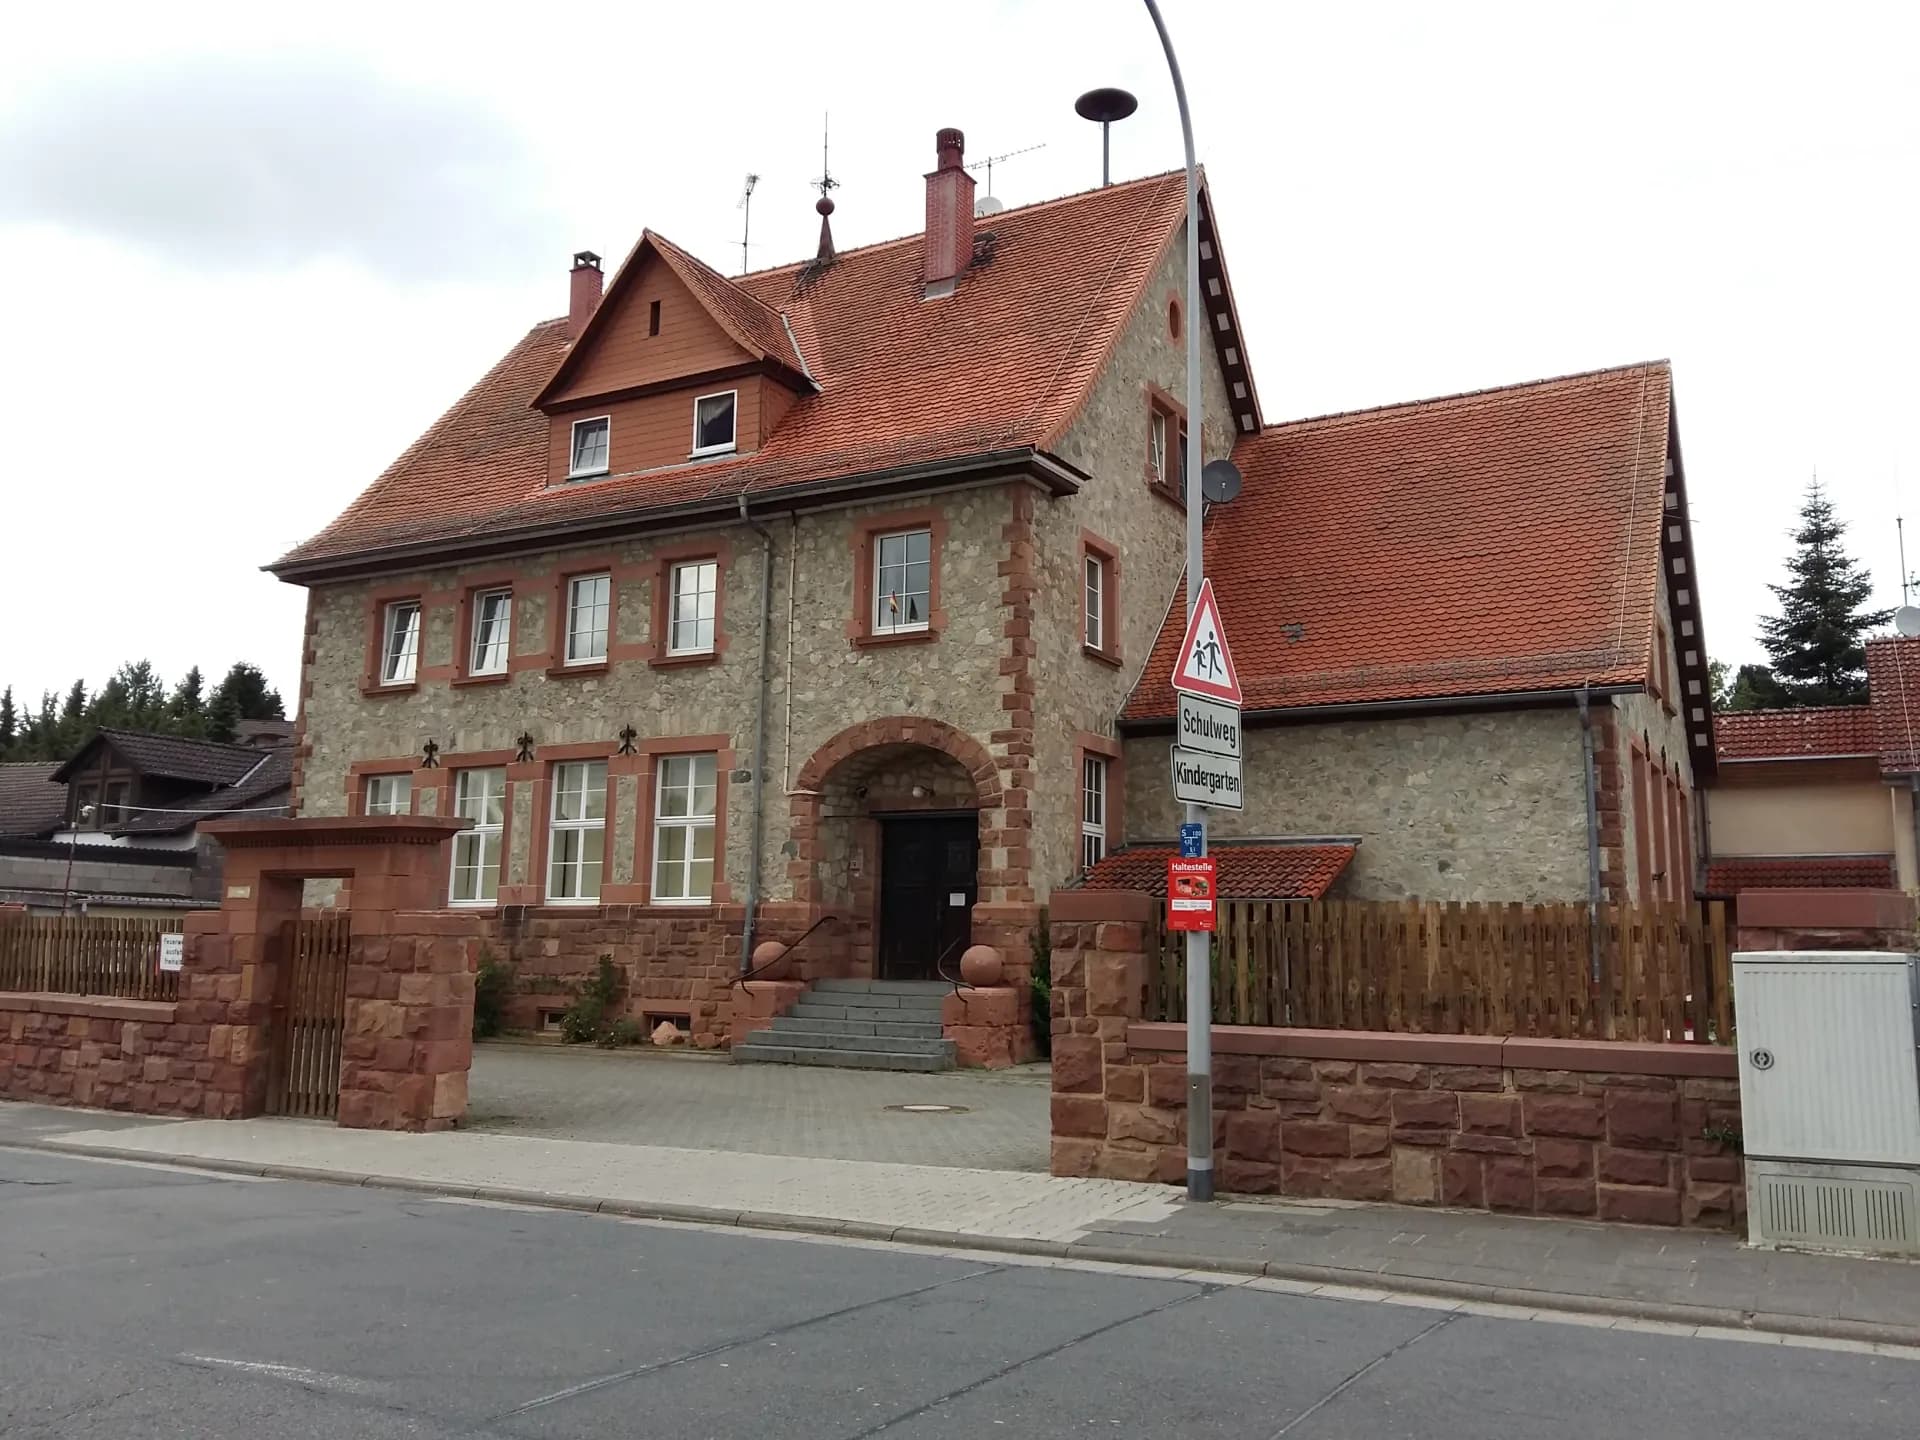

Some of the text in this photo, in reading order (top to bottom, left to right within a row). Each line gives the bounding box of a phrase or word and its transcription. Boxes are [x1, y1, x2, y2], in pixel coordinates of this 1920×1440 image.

[1183, 707, 1236, 749] Schulweg
[1176, 761, 1240, 794] Kindergarten
[1171, 862, 1213, 871] Haltestelle
